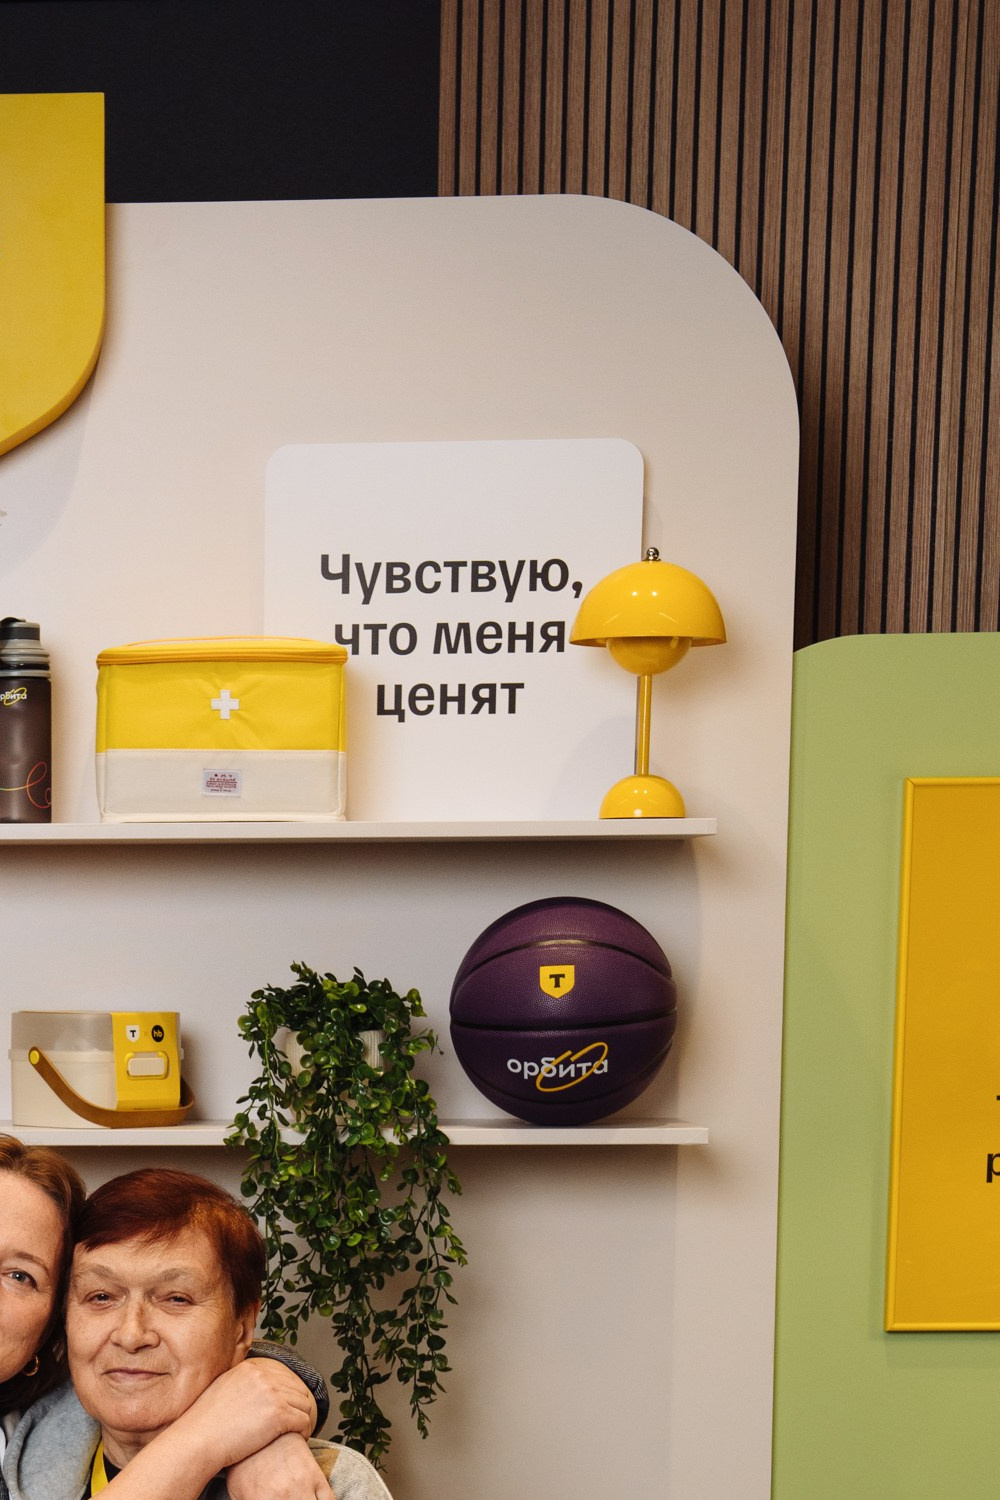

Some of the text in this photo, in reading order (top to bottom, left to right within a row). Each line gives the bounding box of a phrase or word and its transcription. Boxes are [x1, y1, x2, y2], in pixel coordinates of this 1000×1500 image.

[320, 553, 583, 605] Чувствую,
[334, 620, 566, 656] что меня
[376, 682, 525, 723] ценят
[506, 1054, 609, 1081] орбита
